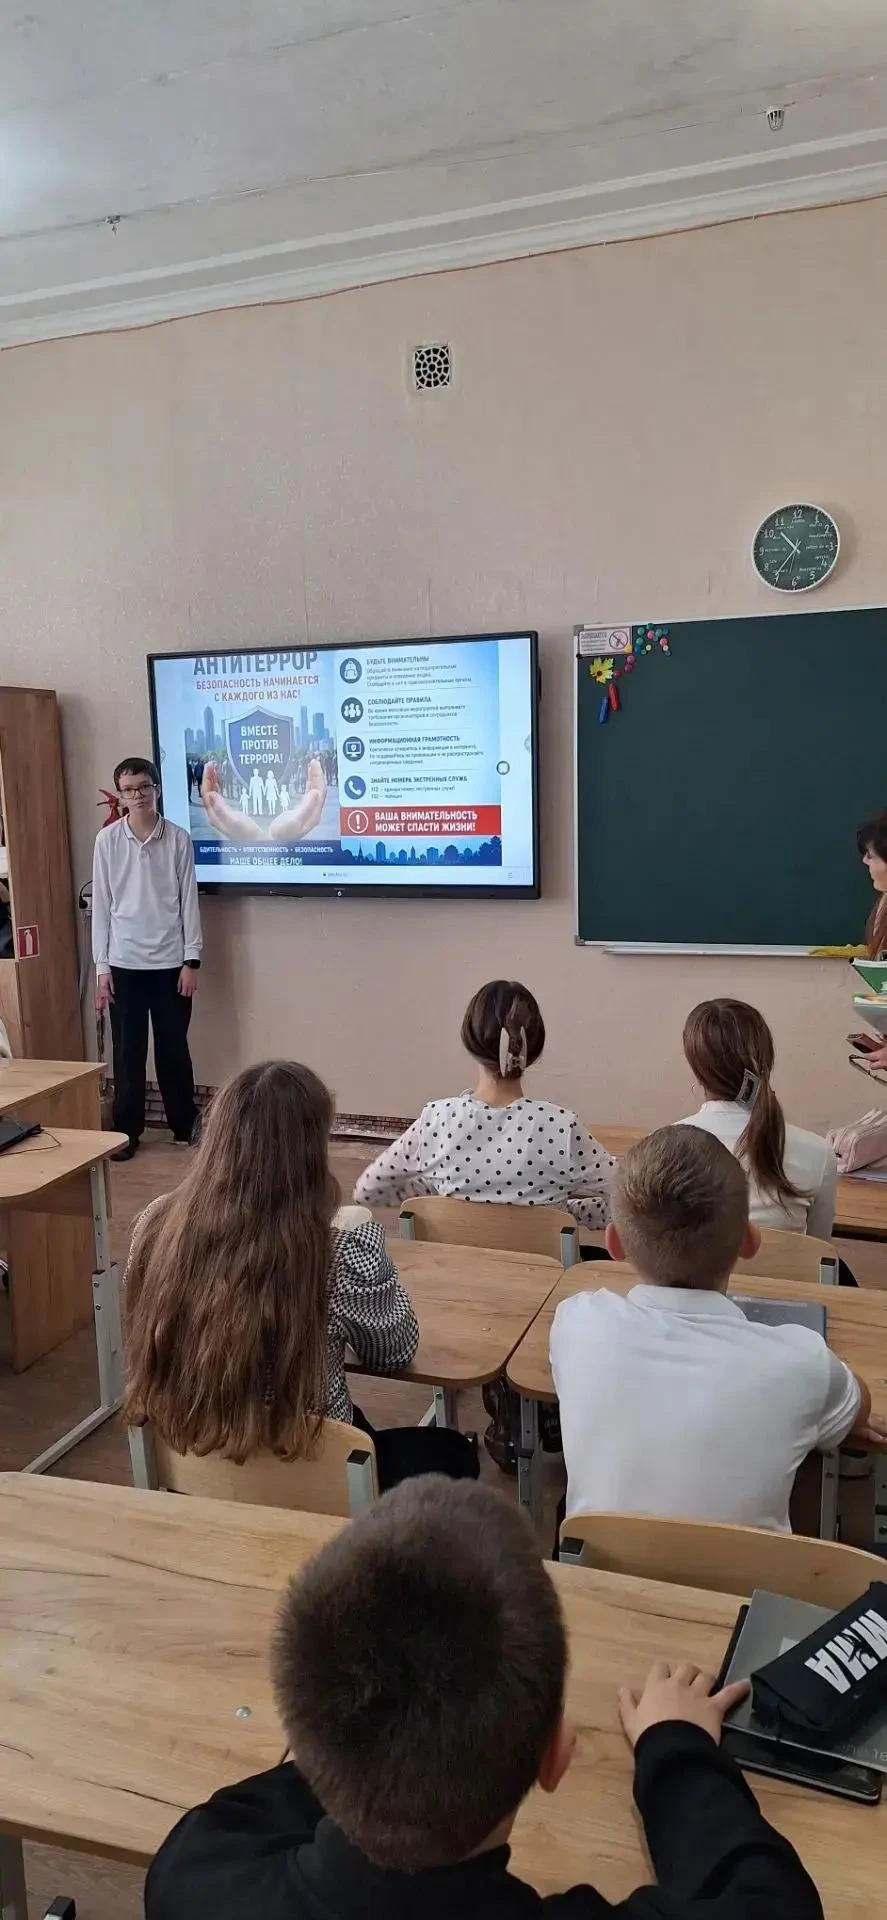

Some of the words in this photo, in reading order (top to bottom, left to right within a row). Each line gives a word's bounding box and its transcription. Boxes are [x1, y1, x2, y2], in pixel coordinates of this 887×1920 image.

[793, 510, 803, 519] 12
[774, 517, 785, 527] 11
[763, 529, 775, 539] 10
[193, 651, 318, 676] АНТИТЕРРОР
[366, 657, 386, 666] БУДЬТЕ
[196, 679, 261, 690] БЕЗОПАСНОСТЬ
[263, 675, 319, 687] НАЧИНАЕТСЯ
[214, 692, 220, 702] С
[222, 691, 265, 703] КАЖДОГО
[266, 690, 279, 700] ИЗ
[281, 689, 301, 699] НАС!
[367, 697, 405, 706] СОБЛЮДАЙТЕ
[406, 696, 432, 704] ПРАВИЛА
[241, 725, 279, 737] ВМЕСТЕ
[241, 739, 279, 750] ПРОТИВ
[369, 736, 421, 744] ИНФОРМАЦИОННАЯ
[422, 735, 461, 743] ГРАМОТНОСТЬ
[239, 753, 283, 764] ТЕРРОРА!
[370, 776, 390, 784] ЗНАЙТЕ
[374, 811, 399, 821] ВАША
[400, 810, 478, 820] ВНИМАТЕЛЬНОСТЬ
[375, 823, 406, 832] МОЖЕТ
[407, 823, 440, 832] СПАСТИ
[441, 822, 476, 832] ЖИЗНИ!
[229, 856, 251, 866] НАШЕ
[252, 856, 278, 866] ОБЩЕЕ
